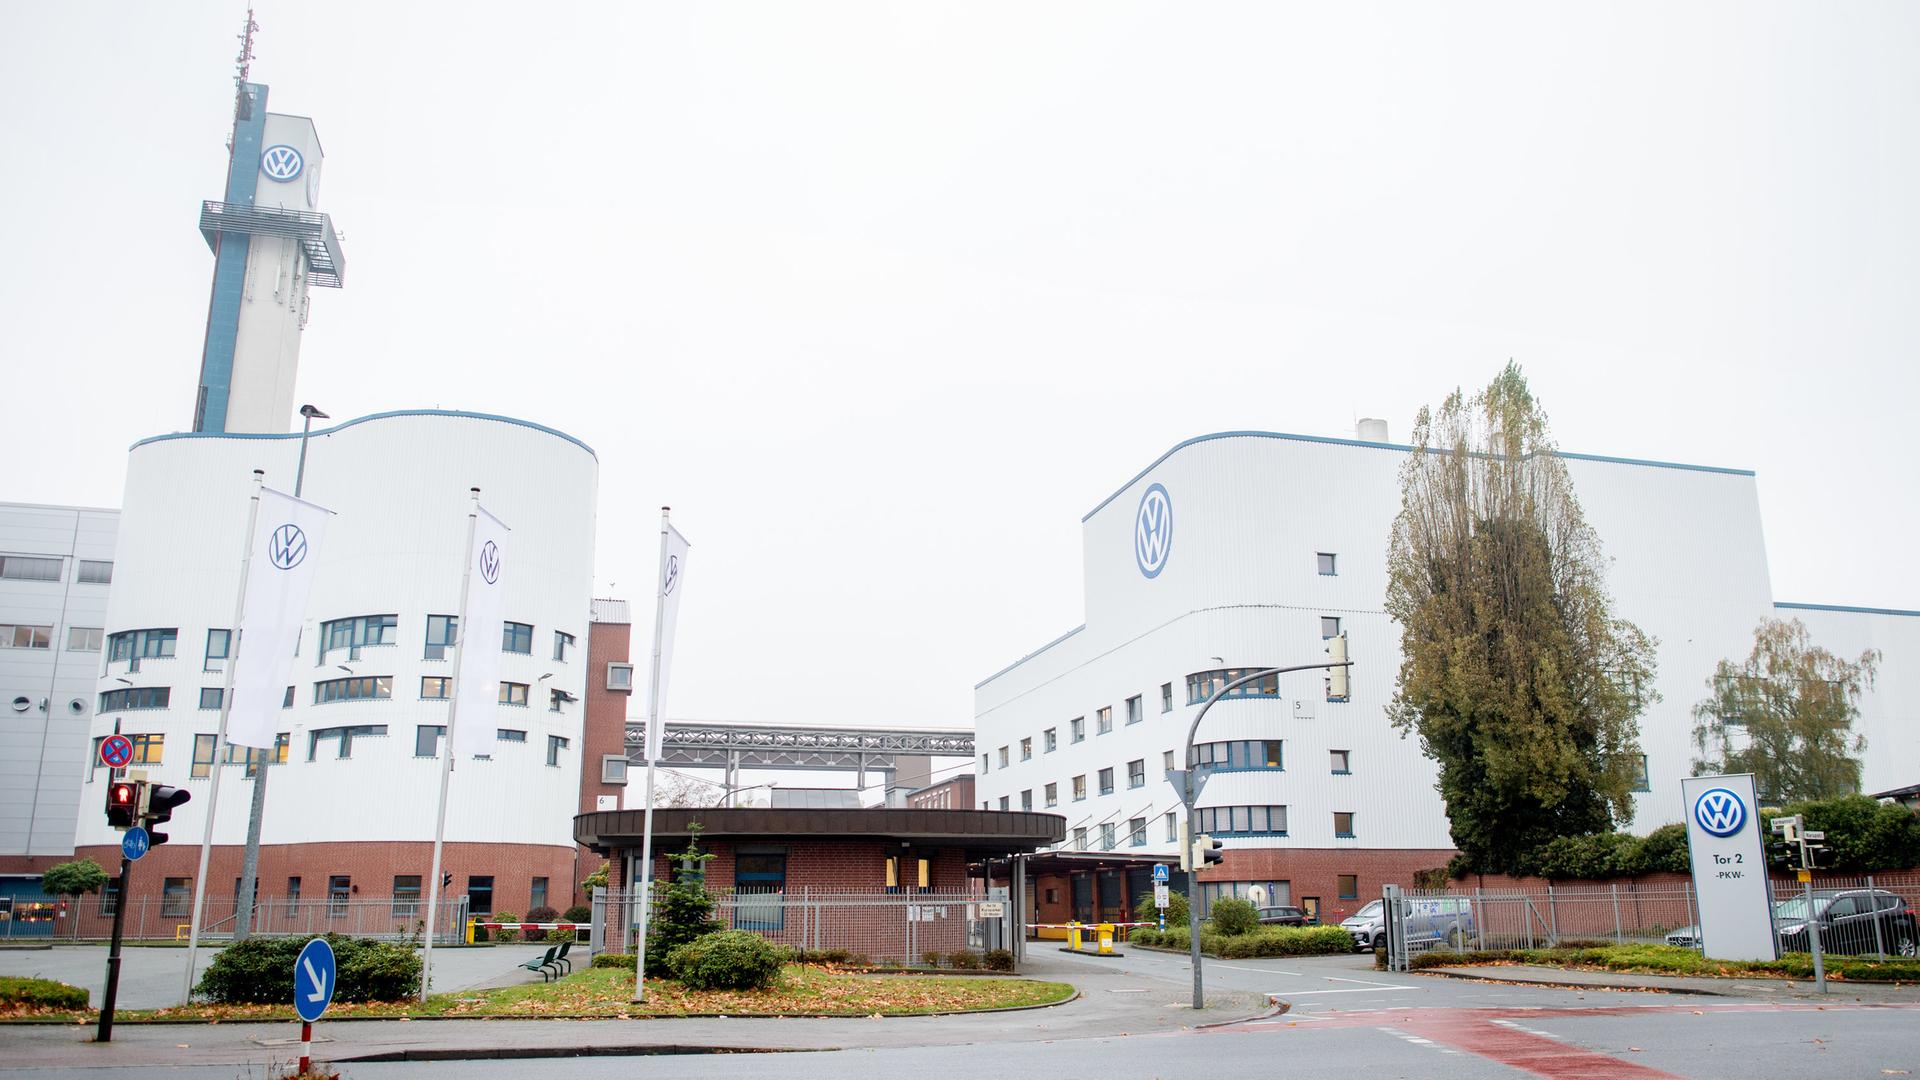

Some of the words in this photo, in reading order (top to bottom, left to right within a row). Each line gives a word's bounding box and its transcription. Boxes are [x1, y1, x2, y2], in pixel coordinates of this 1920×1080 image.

[262, 146, 303, 181] VW
[270, 524, 307, 569] VW
[1136, 485, 1172, 577] VW
[481, 541, 499, 583] VW
[1295, 701, 1301, 710] 5
[599, 796, 605, 805] 6
[1696, 789, 1745, 836] VW
[1713, 854, 1732, 864] Tor
[1735, 853, 1743, 864] 2
[1715, 871, 1745, 879] -PKW-
